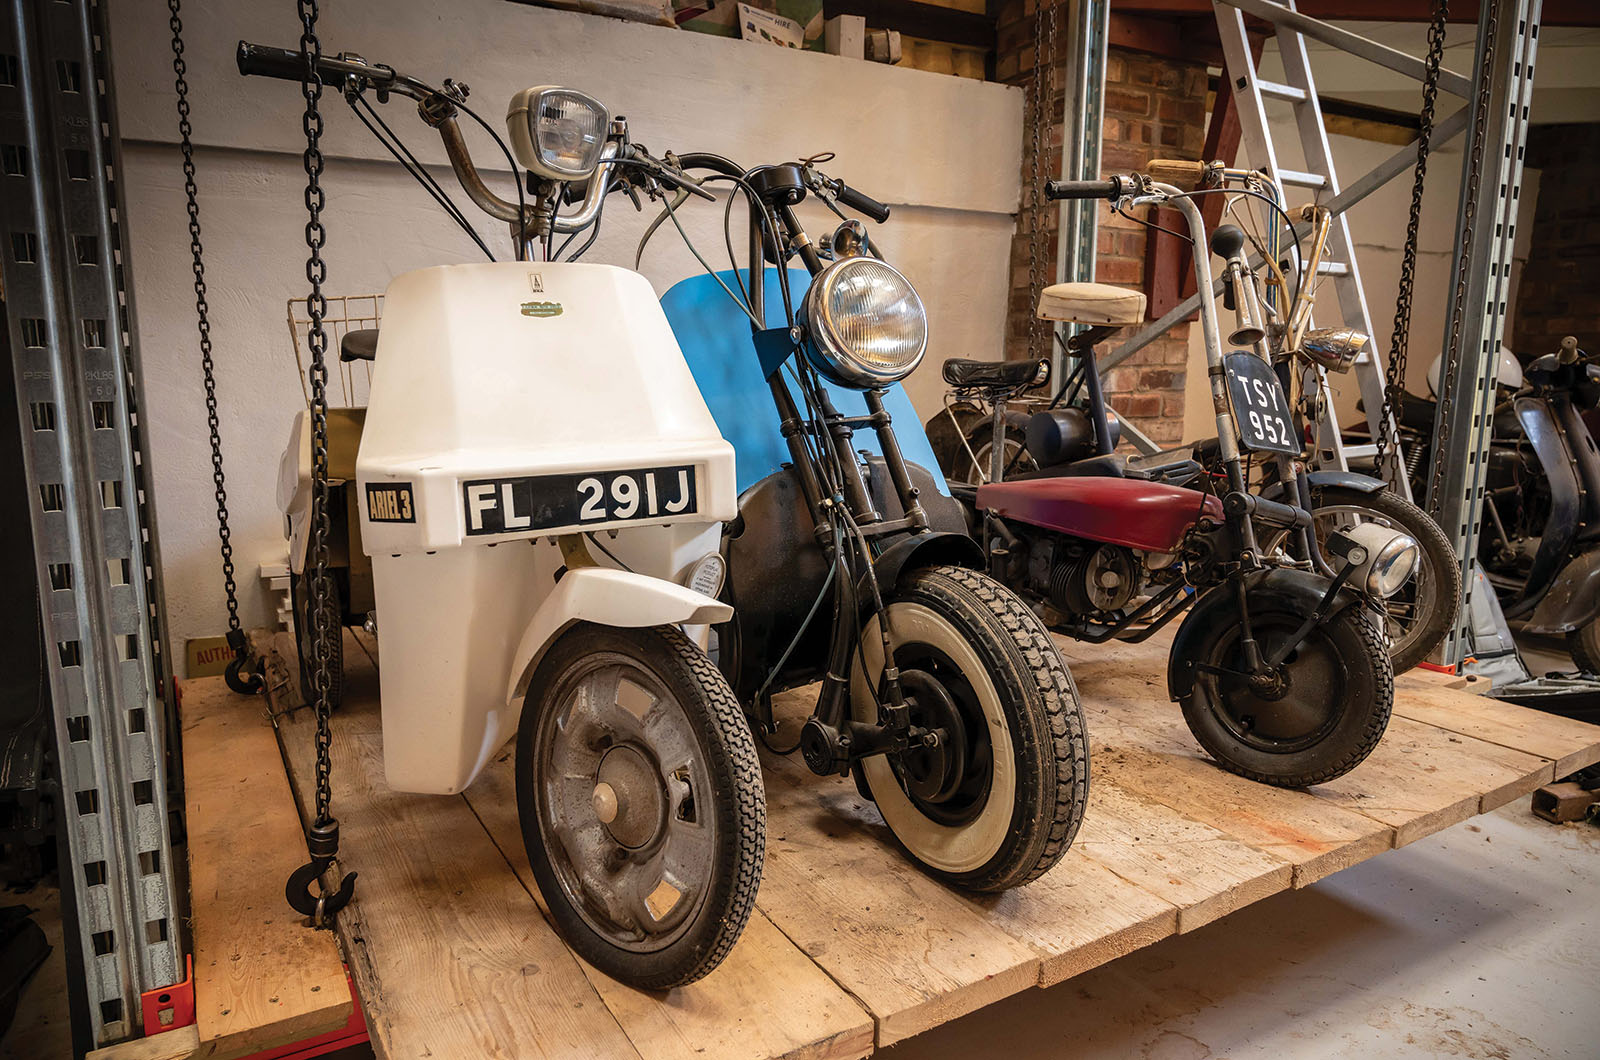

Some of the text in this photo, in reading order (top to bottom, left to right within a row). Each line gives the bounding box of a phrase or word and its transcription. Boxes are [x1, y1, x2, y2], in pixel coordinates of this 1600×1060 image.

[774, 19, 791, 29] HIRE
[1237, 375, 1278, 411] TSY
[1249, 410, 1290, 446] 952
[369, 490, 412, 519] ARIEL 3
[467, 483, 531, 530] FL
